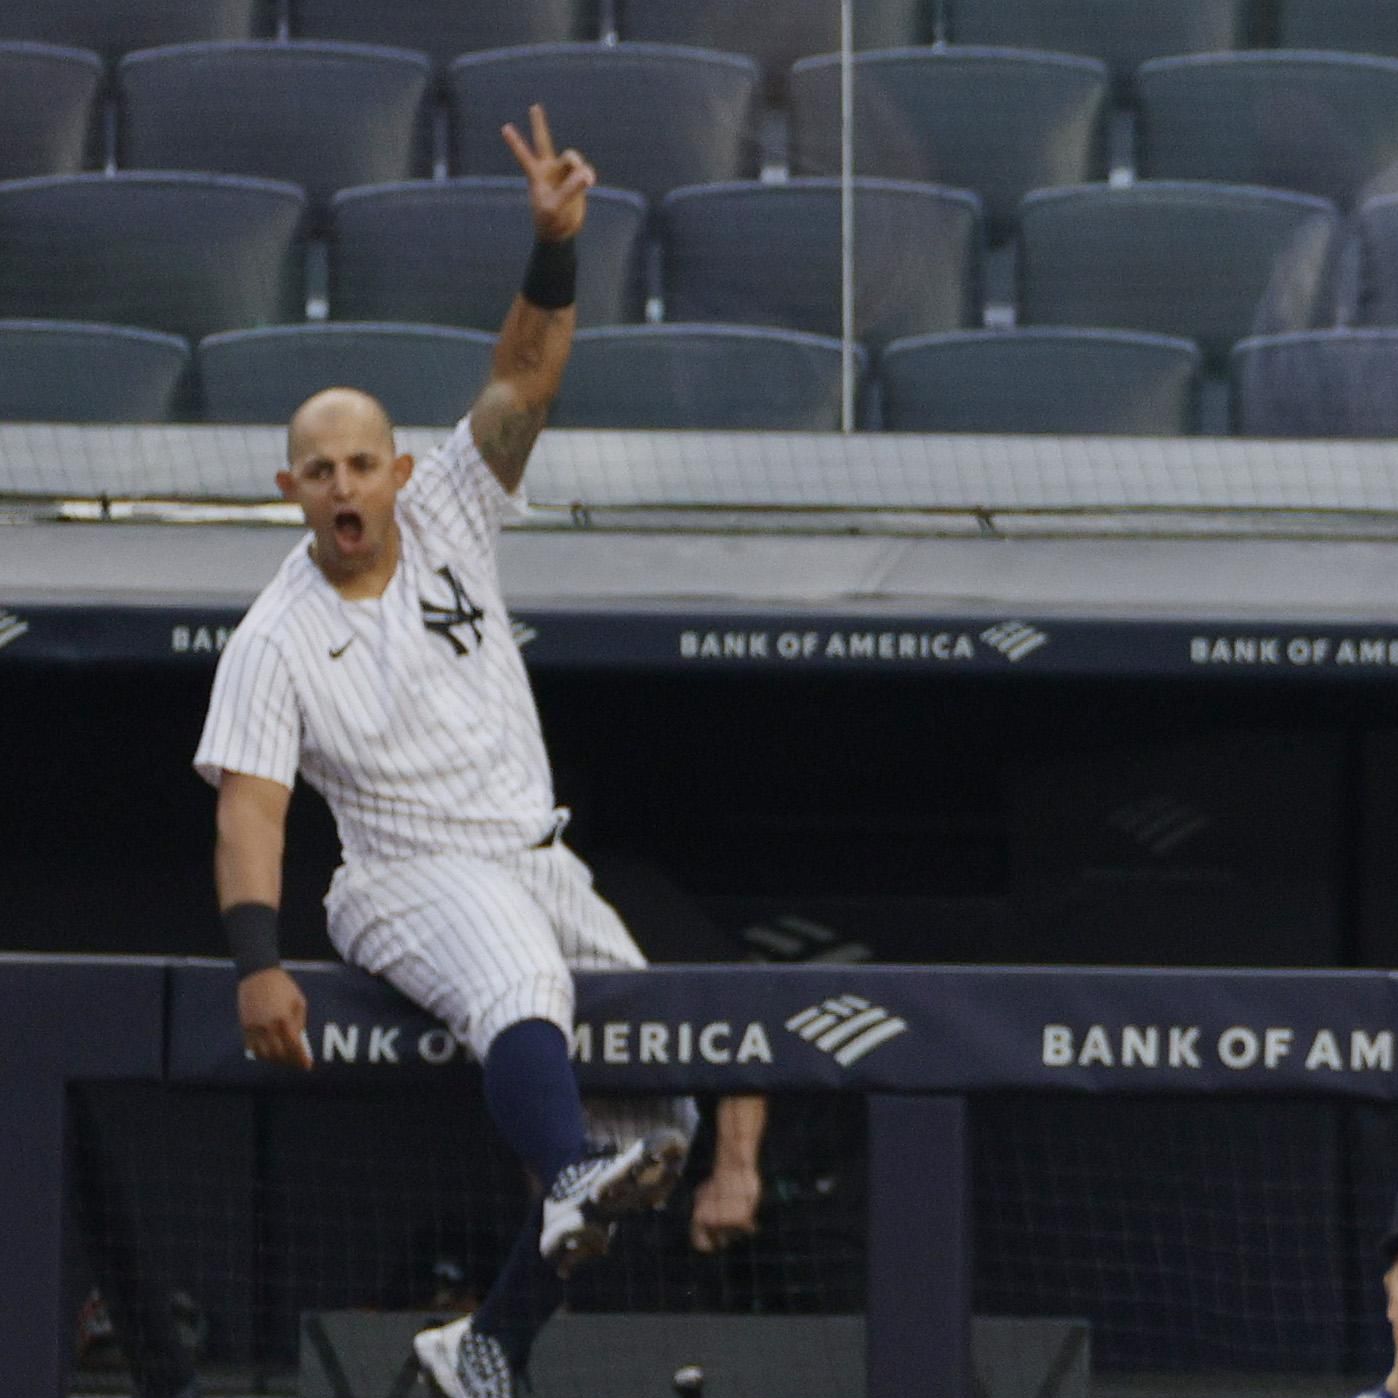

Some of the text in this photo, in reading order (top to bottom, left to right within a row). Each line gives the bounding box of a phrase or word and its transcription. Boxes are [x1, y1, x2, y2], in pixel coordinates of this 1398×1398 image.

[171, 626, 237, 653] BAN
[680, 631, 974, 660] BANK OF AMERICA
[1190, 636, 1280, 664] BANK
[1287, 637, 1330, 665] OF
[569, 1022, 773, 1065] MERICA
[1041, 1024, 1201, 1068] BANK
[1217, 1026, 1294, 1070] OF
